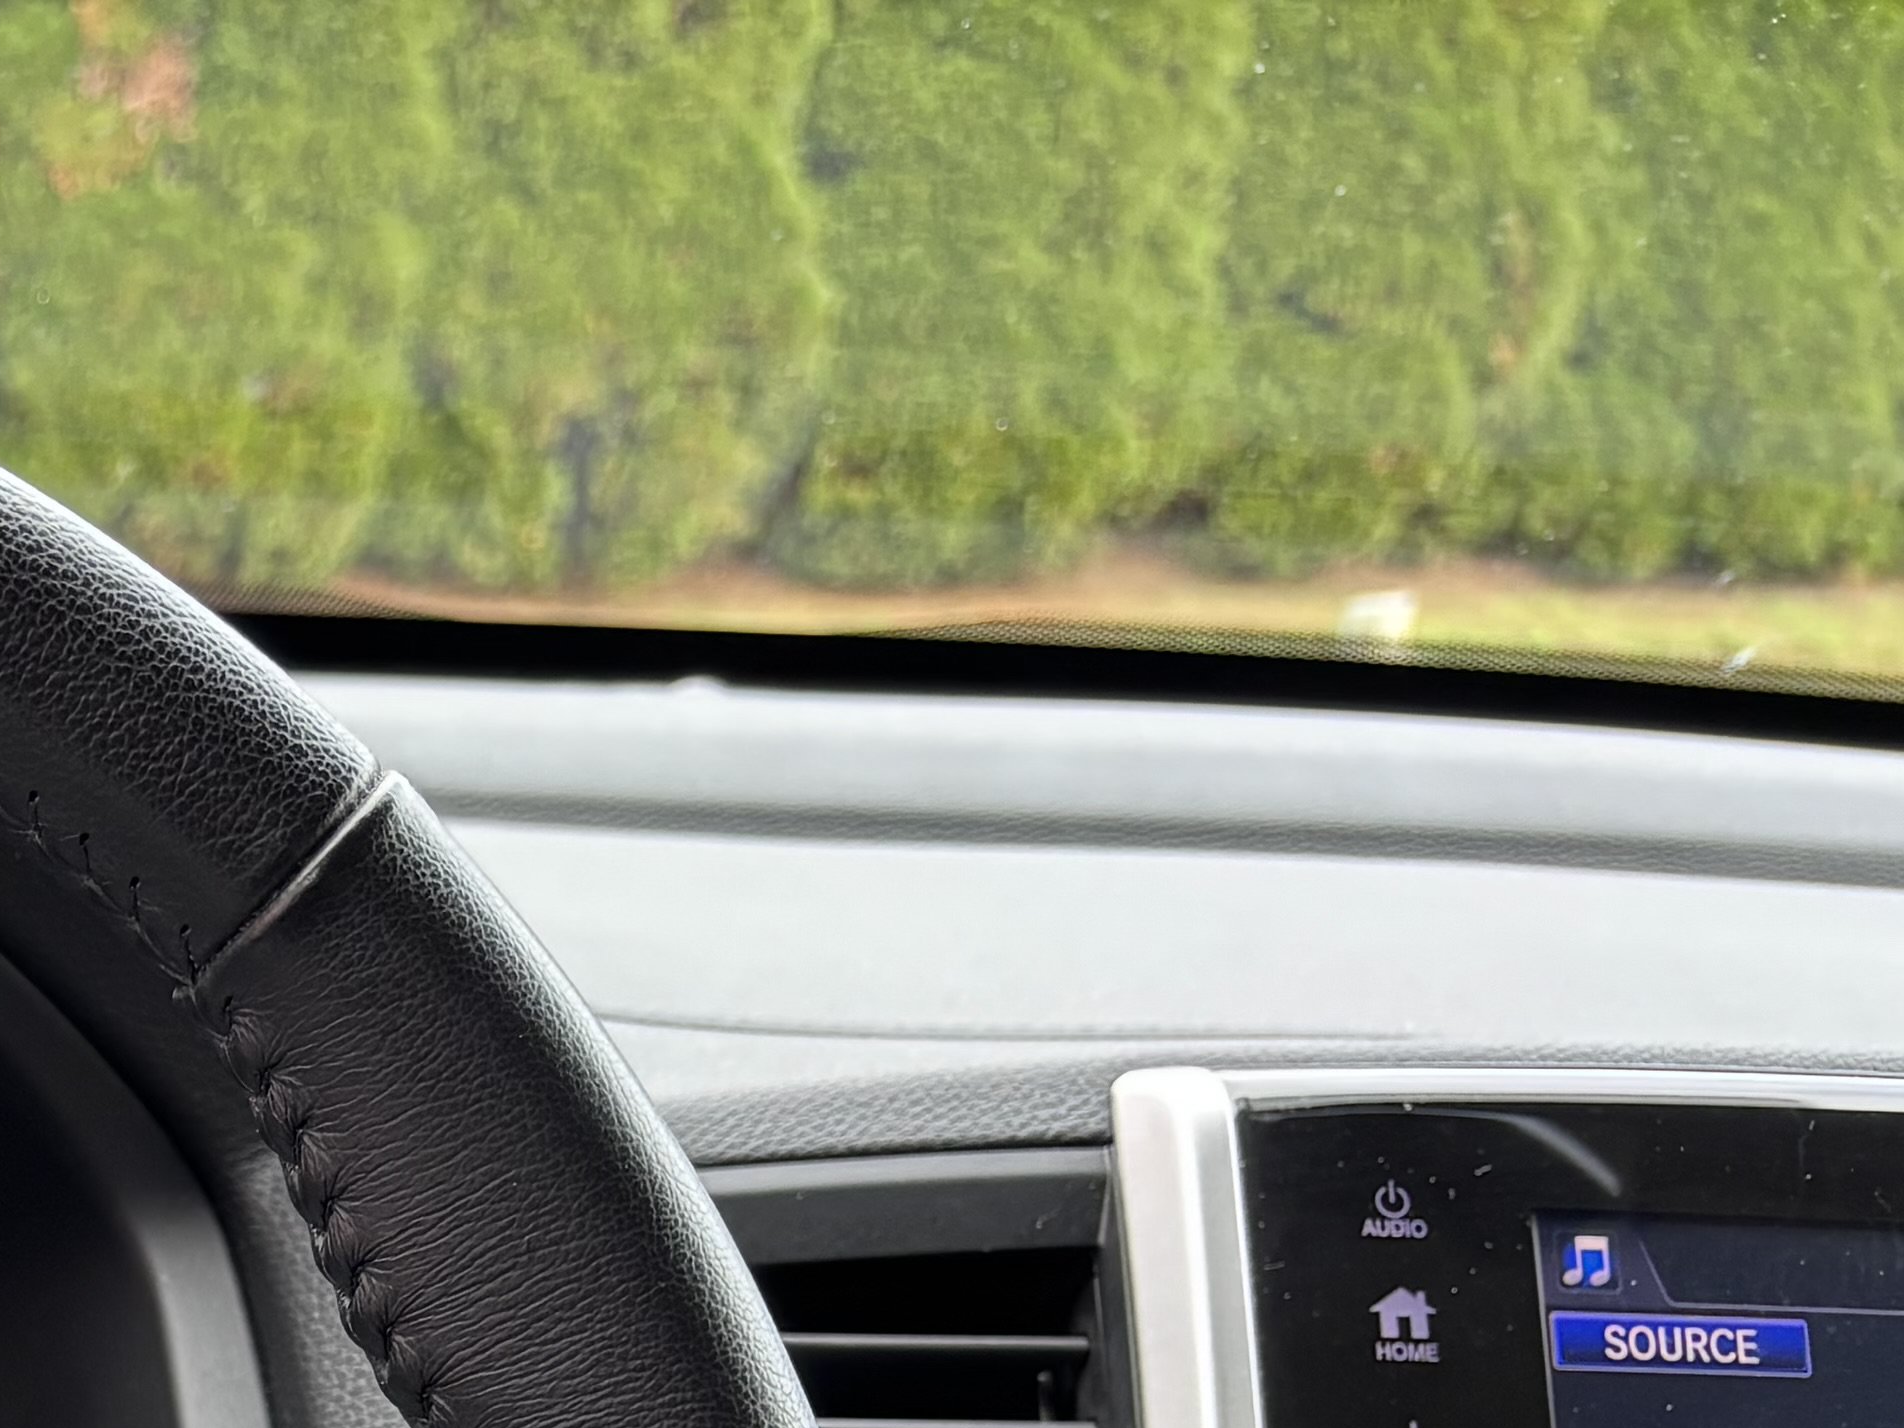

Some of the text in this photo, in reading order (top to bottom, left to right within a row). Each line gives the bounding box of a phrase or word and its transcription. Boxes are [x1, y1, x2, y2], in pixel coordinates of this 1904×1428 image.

[1361, 1217, 1428, 1240] AUDIO
[1374, 1341, 1440, 1364] HOME
[1602, 1325, 1760, 1367] SOURCE
